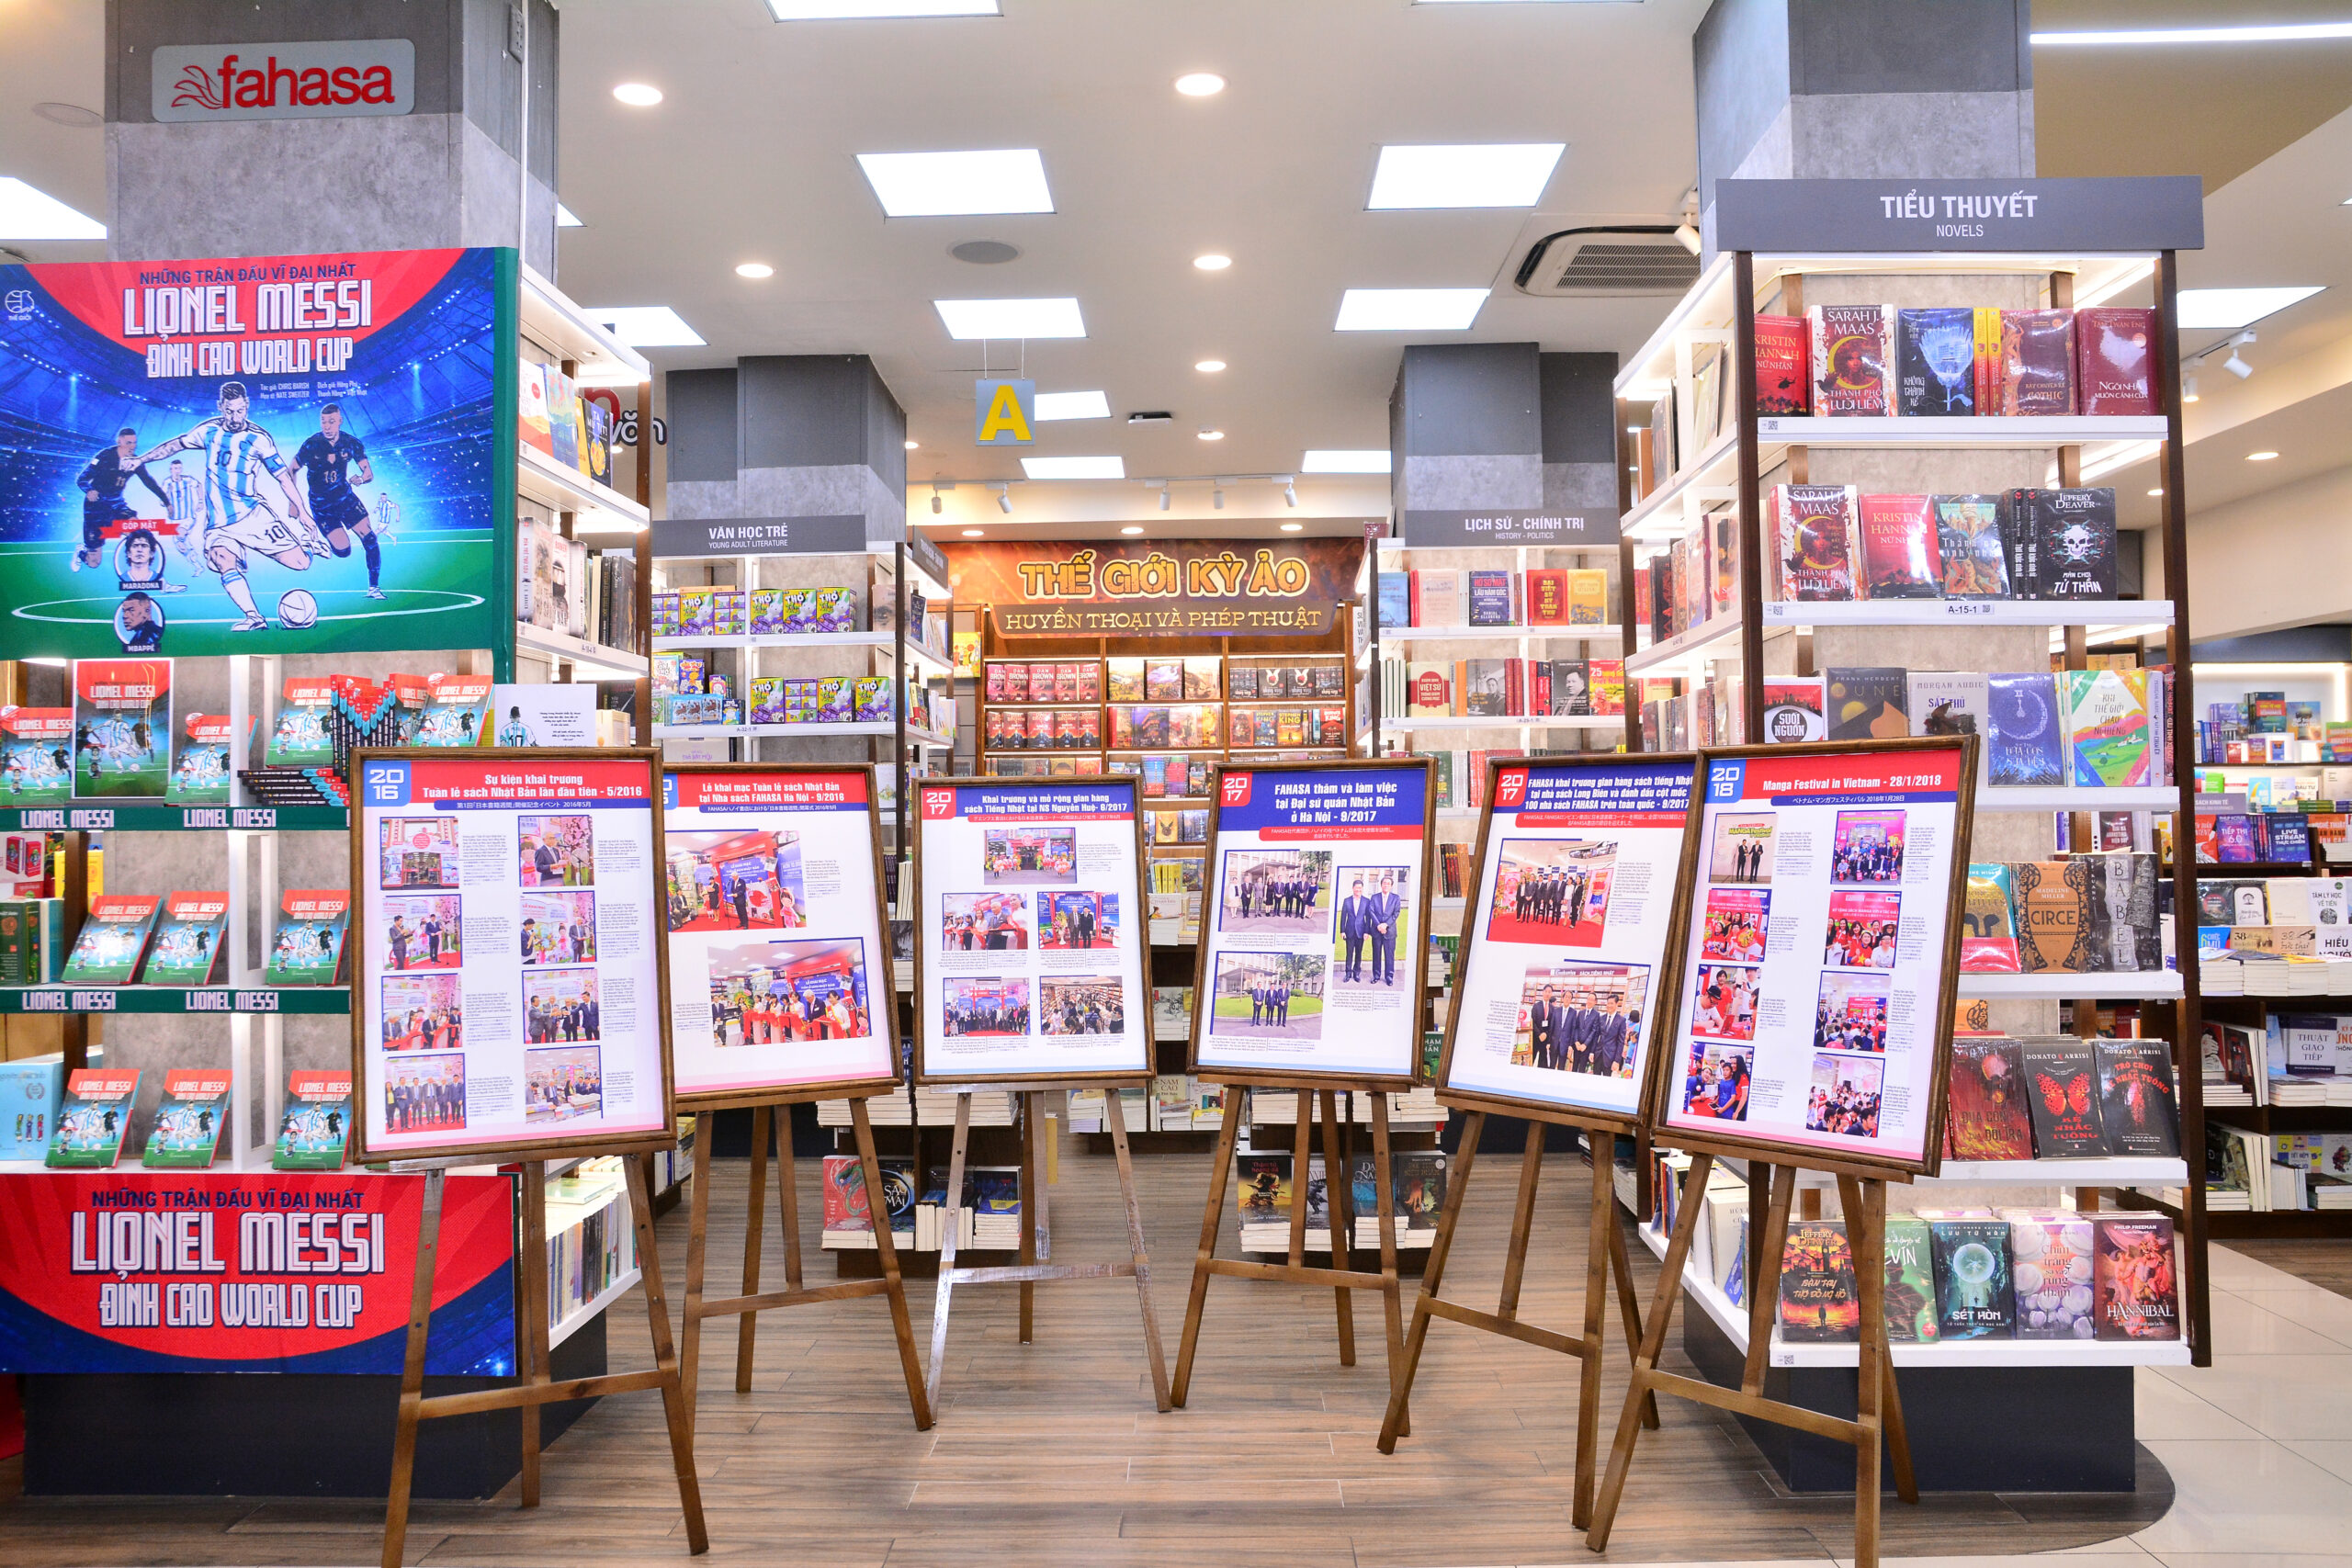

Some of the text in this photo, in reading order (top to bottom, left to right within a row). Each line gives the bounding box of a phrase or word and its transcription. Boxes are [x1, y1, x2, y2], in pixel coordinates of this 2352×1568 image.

[218, 53, 395, 109] fahasa
[1880, 188, 2038, 218] TIỂU THUYẾT
[1937, 224, 1984, 237] NOVELS
[140, 263, 356, 285] NHỮNG TRẬN ĐẤU VĨ ĐẠI NHẤT
[125, 279, 371, 335] LIONEL MESSI
[1828, 310, 1870, 322] SARAH
[1834, 323, 1874, 335] MAAS
[145, 334, 353, 378] ĐỈNH CAO WORLD CUP
[978, 385, 1032, 441] A
[2055, 501, 2096, 509] DEAVER
[708, 522, 787, 539] VĂN HỌC TRẺ
[1465, 515, 1584, 532] LỊCH SỬ CHÍNH TRỊ
[265, 522, 284, 543] 10
[1527, 531, 1555, 539] POLITICS
[752, 539, 788, 547] LITERATURE
[1017, 549, 1310, 599] THẾ GIỚI KỲ ẢO
[1948, 605, 1977, 614] A-15-1
[1005, 606, 1321, 633] HUYỀN THOẠI VÀ PHÉP THUẬT
[128, 644, 154, 652] MBAPPÉ
[369, 769, 404, 784] 20
[485, 774, 498, 785] Sự
[501, 774, 522, 785] kiện
[525, 774, 546, 784] khai
[1711, 767, 1740, 781] 20
[1224, 777, 1247, 789] 20
[1274, 782, 1396, 795] FAHASA thăm và làm việc
[1713, 783, 1734, 796] 18
[1763, 774, 1941, 792] Manga Festival in Vietnam 28/1/2018
[373, 784, 399, 799] 16
[463, 787, 488, 797] sách
[491, 787, 514, 798] Nhật
[517, 786, 537, 797] Bản
[539, 786, 554, 796] lần
[557, 786, 575, 796] đầu
[578, 786, 597, 796] tiên
[606, 786, 642, 796] 5/2016
[926, 792, 951, 803] 20
[1227, 790, 1242, 801] 17
[930, 804, 947, 815] 17
[1275, 795, 1395, 810] tại Đại sứ quán Nhật Bản
[21, 809, 114, 829] LIONEL MESSI
[1291, 810, 1376, 823] ở Hà Nội 9/2017
[2030, 910, 2076, 925] CIRCE
[186, 991, 278, 1010] LIONEL MESSI
[92, 1188, 364, 1212] NHỮNG TRẬN ĐẤU VĨ ĐẠI NHẤT
[74, 1213, 384, 1272] LIONEL MESSI
[99, 1273, 362, 1326] ĐỈNH CAO WORLD CUP
[1952, 1307, 1975, 1320] SÉT
[2107, 1302, 2174, 1320] HANNIBAL
